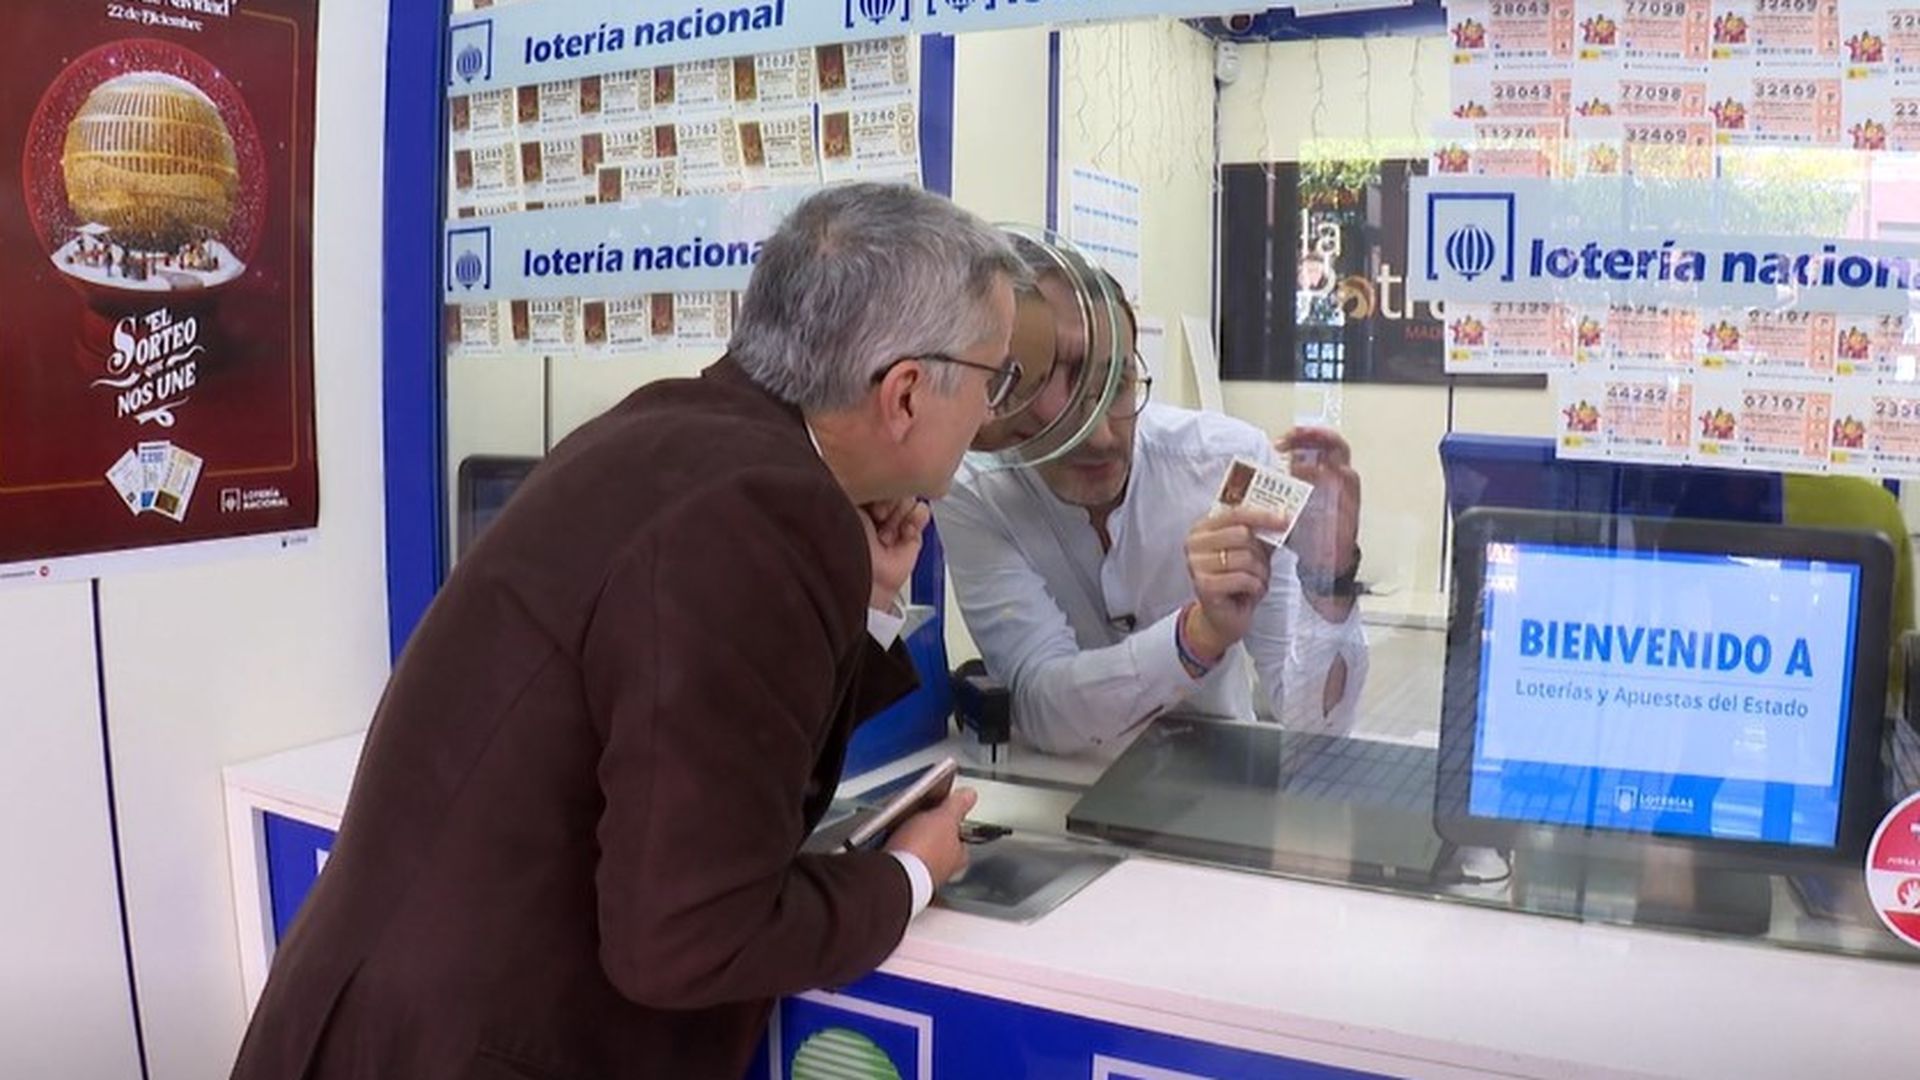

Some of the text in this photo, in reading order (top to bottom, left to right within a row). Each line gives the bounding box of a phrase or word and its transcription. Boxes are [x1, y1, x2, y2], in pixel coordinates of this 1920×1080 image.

[524, 0, 785, 65] lotería nacional
[1493, 84, 1552, 99] 28643
[1621, 84, 1682, 100] 77098
[1755, 83, 1817, 99] 32469
[523, 238, 765, 277] lotería naciona
[1529, 241, 1706, 283] lotería
[147, 307, 172, 333] EL
[107, 316, 197, 376] SORTEO
[118, 361, 197, 418] NOS UNE
[1520, 618, 1814, 678] BIENVENIDO A
[1515, 678, 1809, 718] Loterías y Apuestas del Estado
